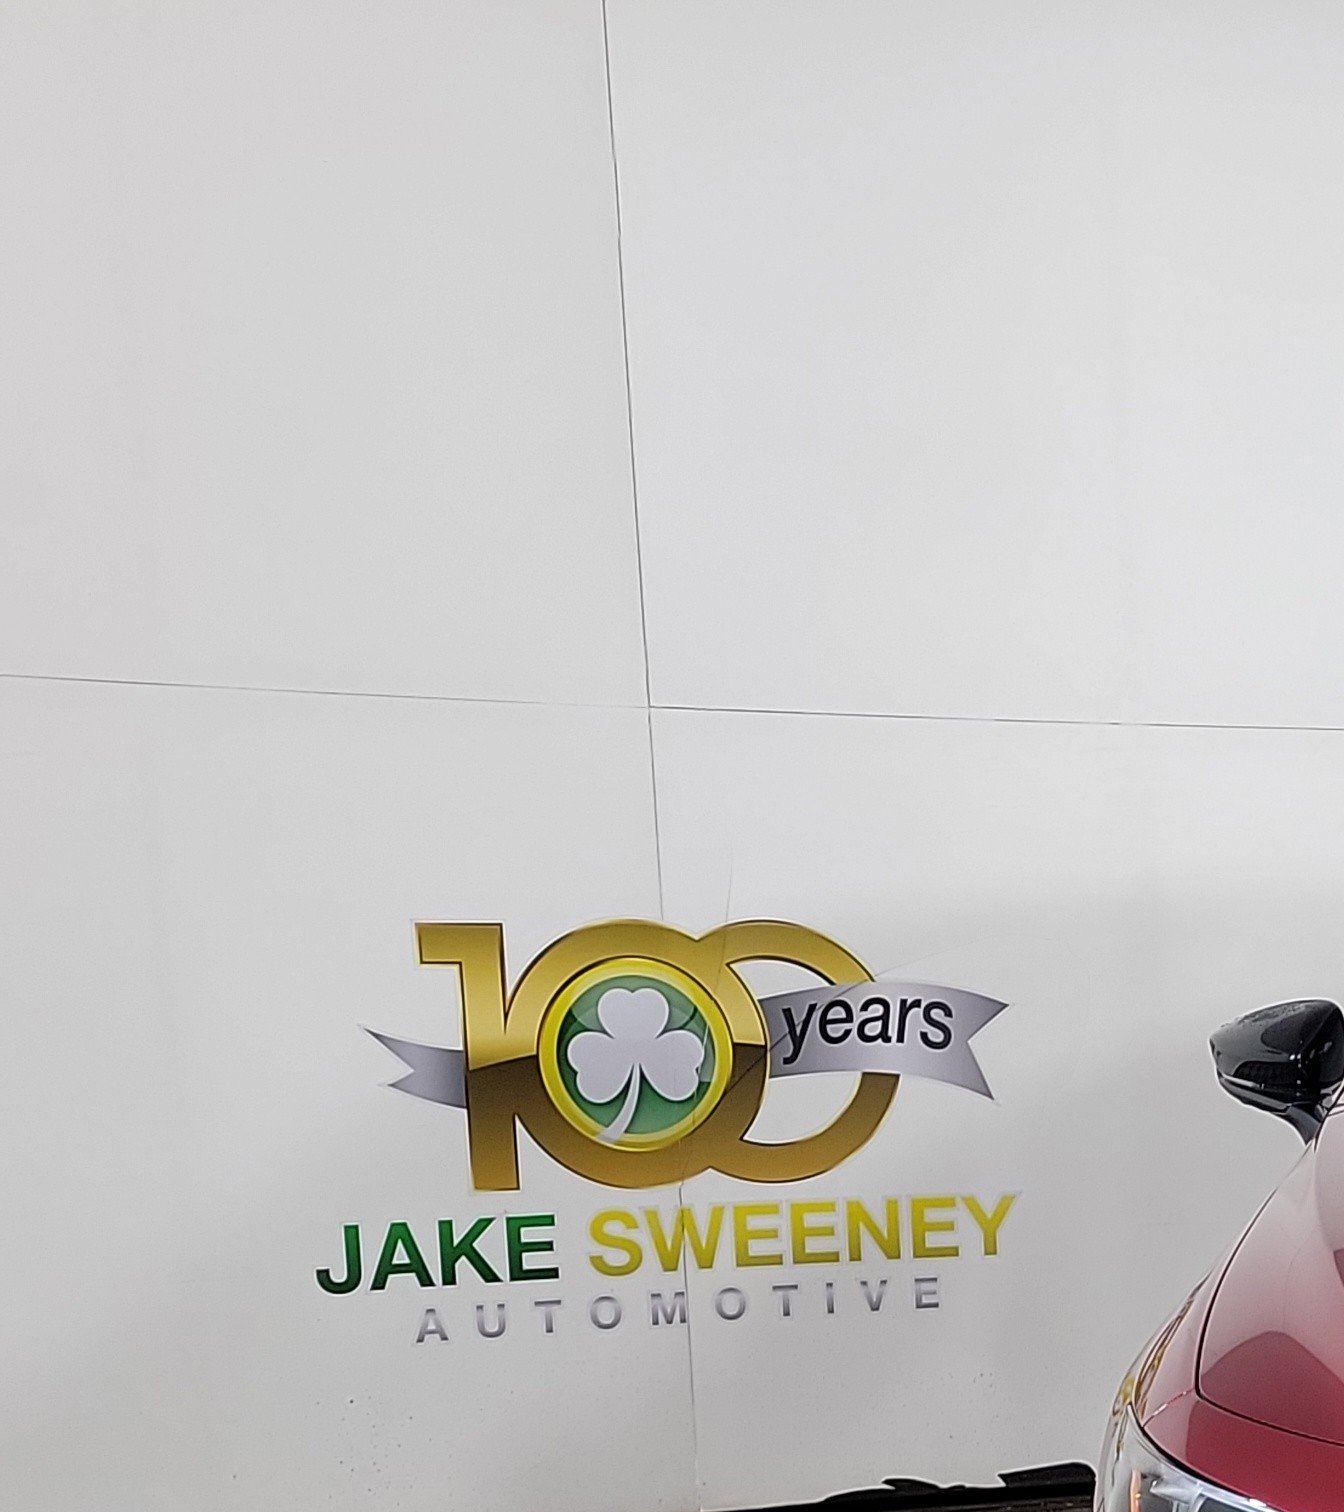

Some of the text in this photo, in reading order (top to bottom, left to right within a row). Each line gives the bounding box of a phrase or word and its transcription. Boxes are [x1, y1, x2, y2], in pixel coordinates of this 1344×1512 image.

[414, 919, 953, 1191] 100 years
[315, 1194, 1016, 1295] JAKE SWEENEY
[416, 1277, 941, 1344] AUTOMOTIVE
